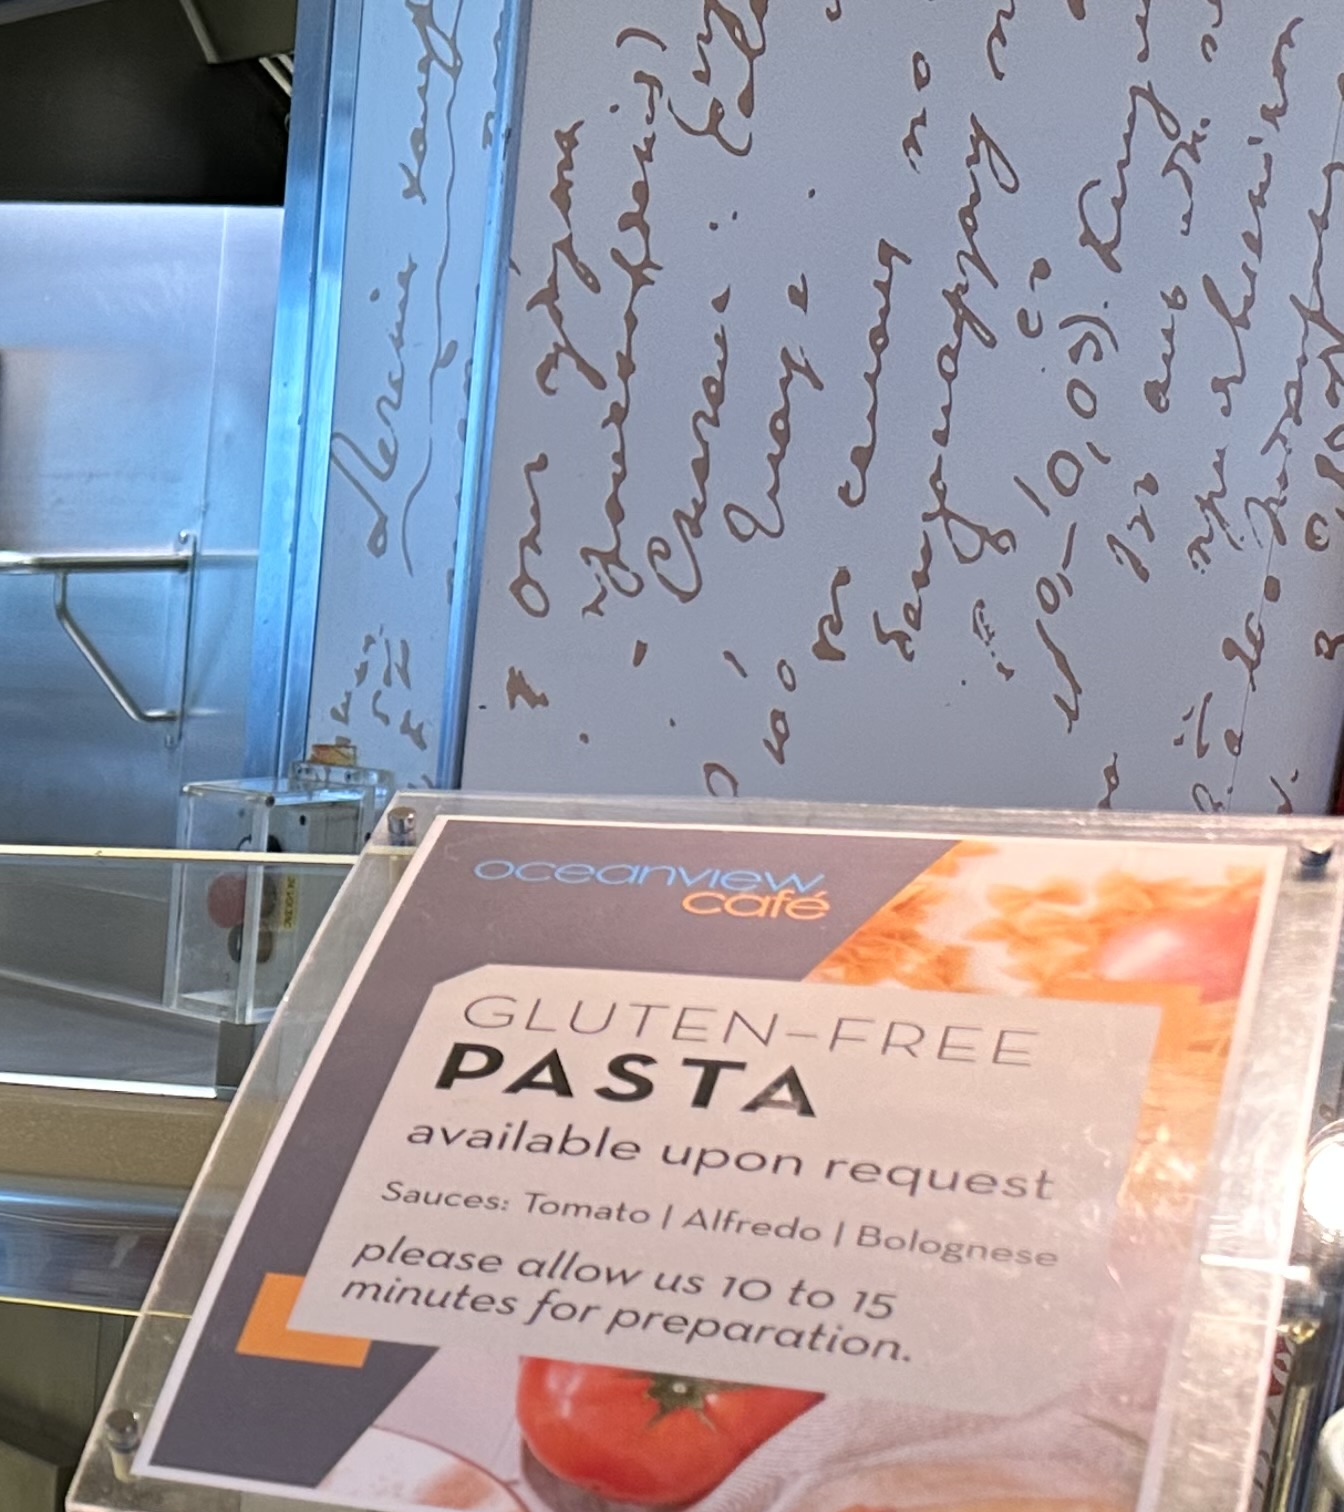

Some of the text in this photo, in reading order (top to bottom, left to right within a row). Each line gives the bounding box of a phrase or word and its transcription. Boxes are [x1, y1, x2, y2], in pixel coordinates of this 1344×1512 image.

[473, 859, 825, 894] oceanview
[681, 888, 831, 921] café
[462, 994, 1039, 1067] GLUTEN-FREE
[433, 1041, 818, 1118] PASTA
[406, 1119, 1055, 1201] available upon request
[381, 1181, 510, 1211] Sauces:
[525, 1192, 652, 1225] Tomato
[682, 1208, 822, 1242] Alfredo
[856, 1224, 1060, 1268] Bolognese
[351, 1235, 898, 1320] please allow us 10 to 15
[341, 1276, 912, 1362] minutes for preparation.
